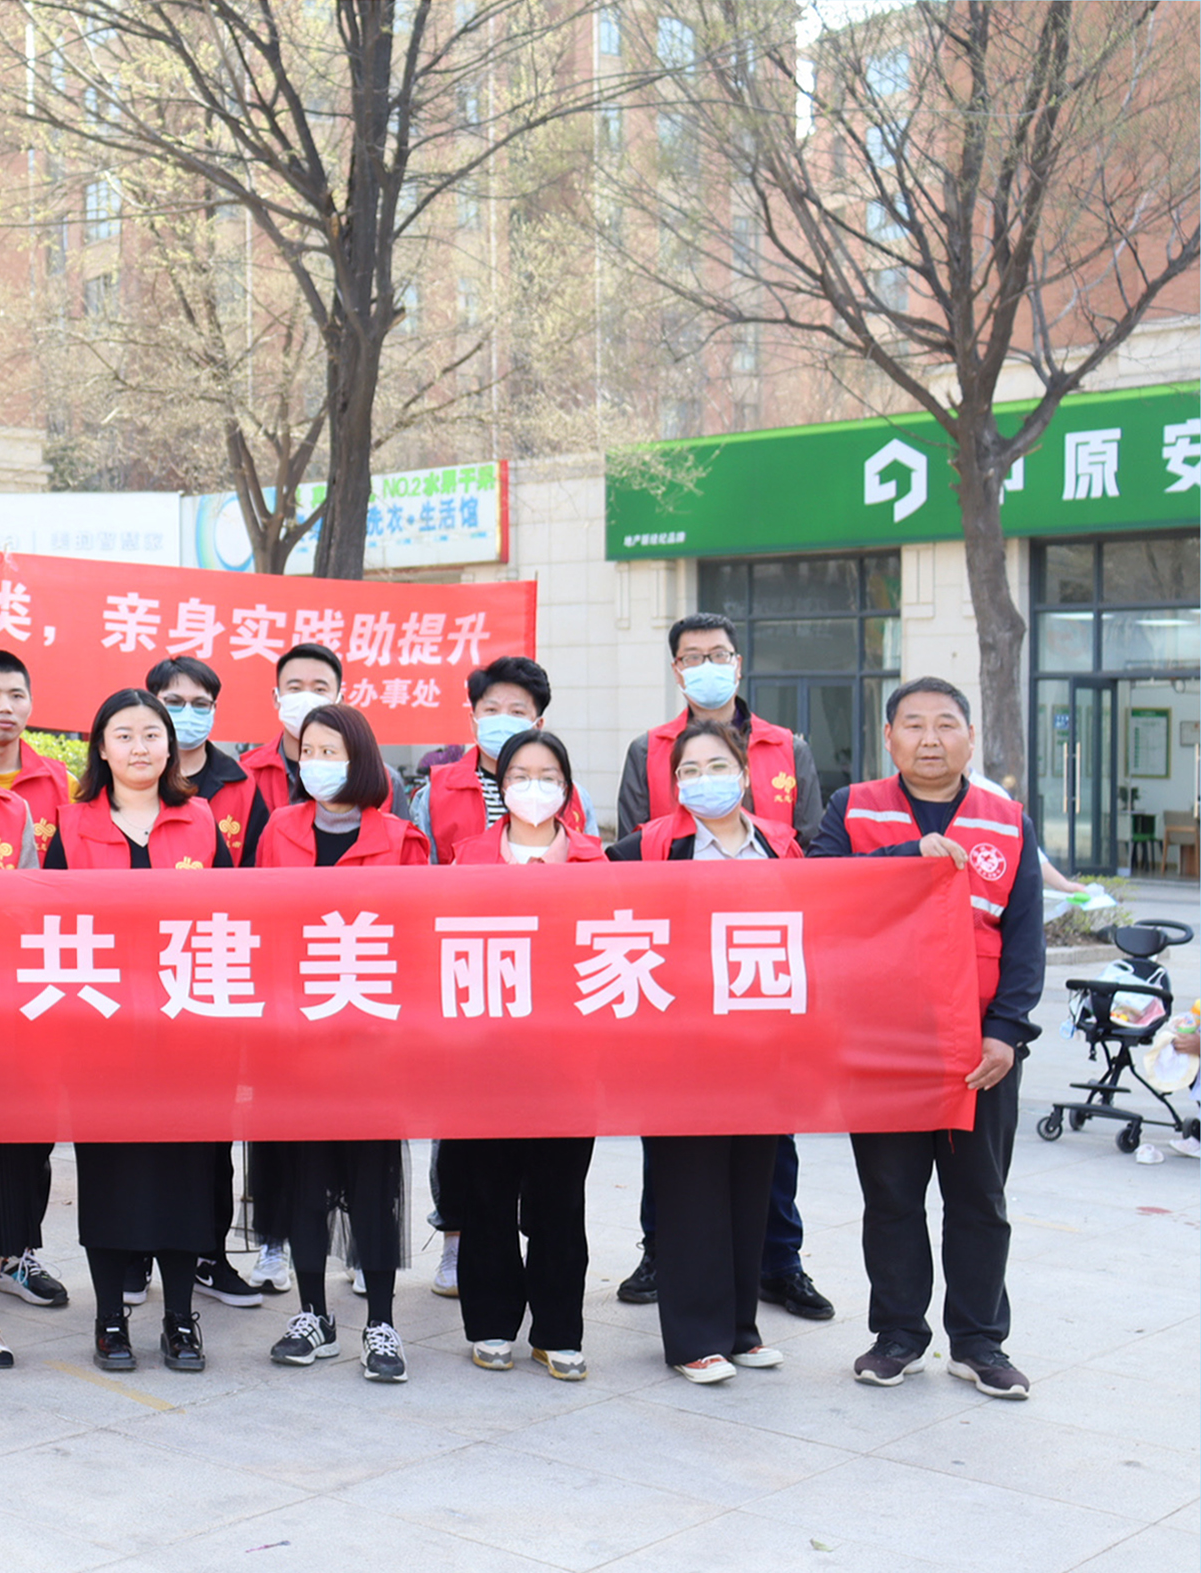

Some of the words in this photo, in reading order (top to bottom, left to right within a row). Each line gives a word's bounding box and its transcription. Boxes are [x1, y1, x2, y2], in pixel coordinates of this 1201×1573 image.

[999, 418, 1201, 505] 原安
[340, 677, 442, 709] 办事处
[16, 909, 808, 1021] 共建美丽家园
